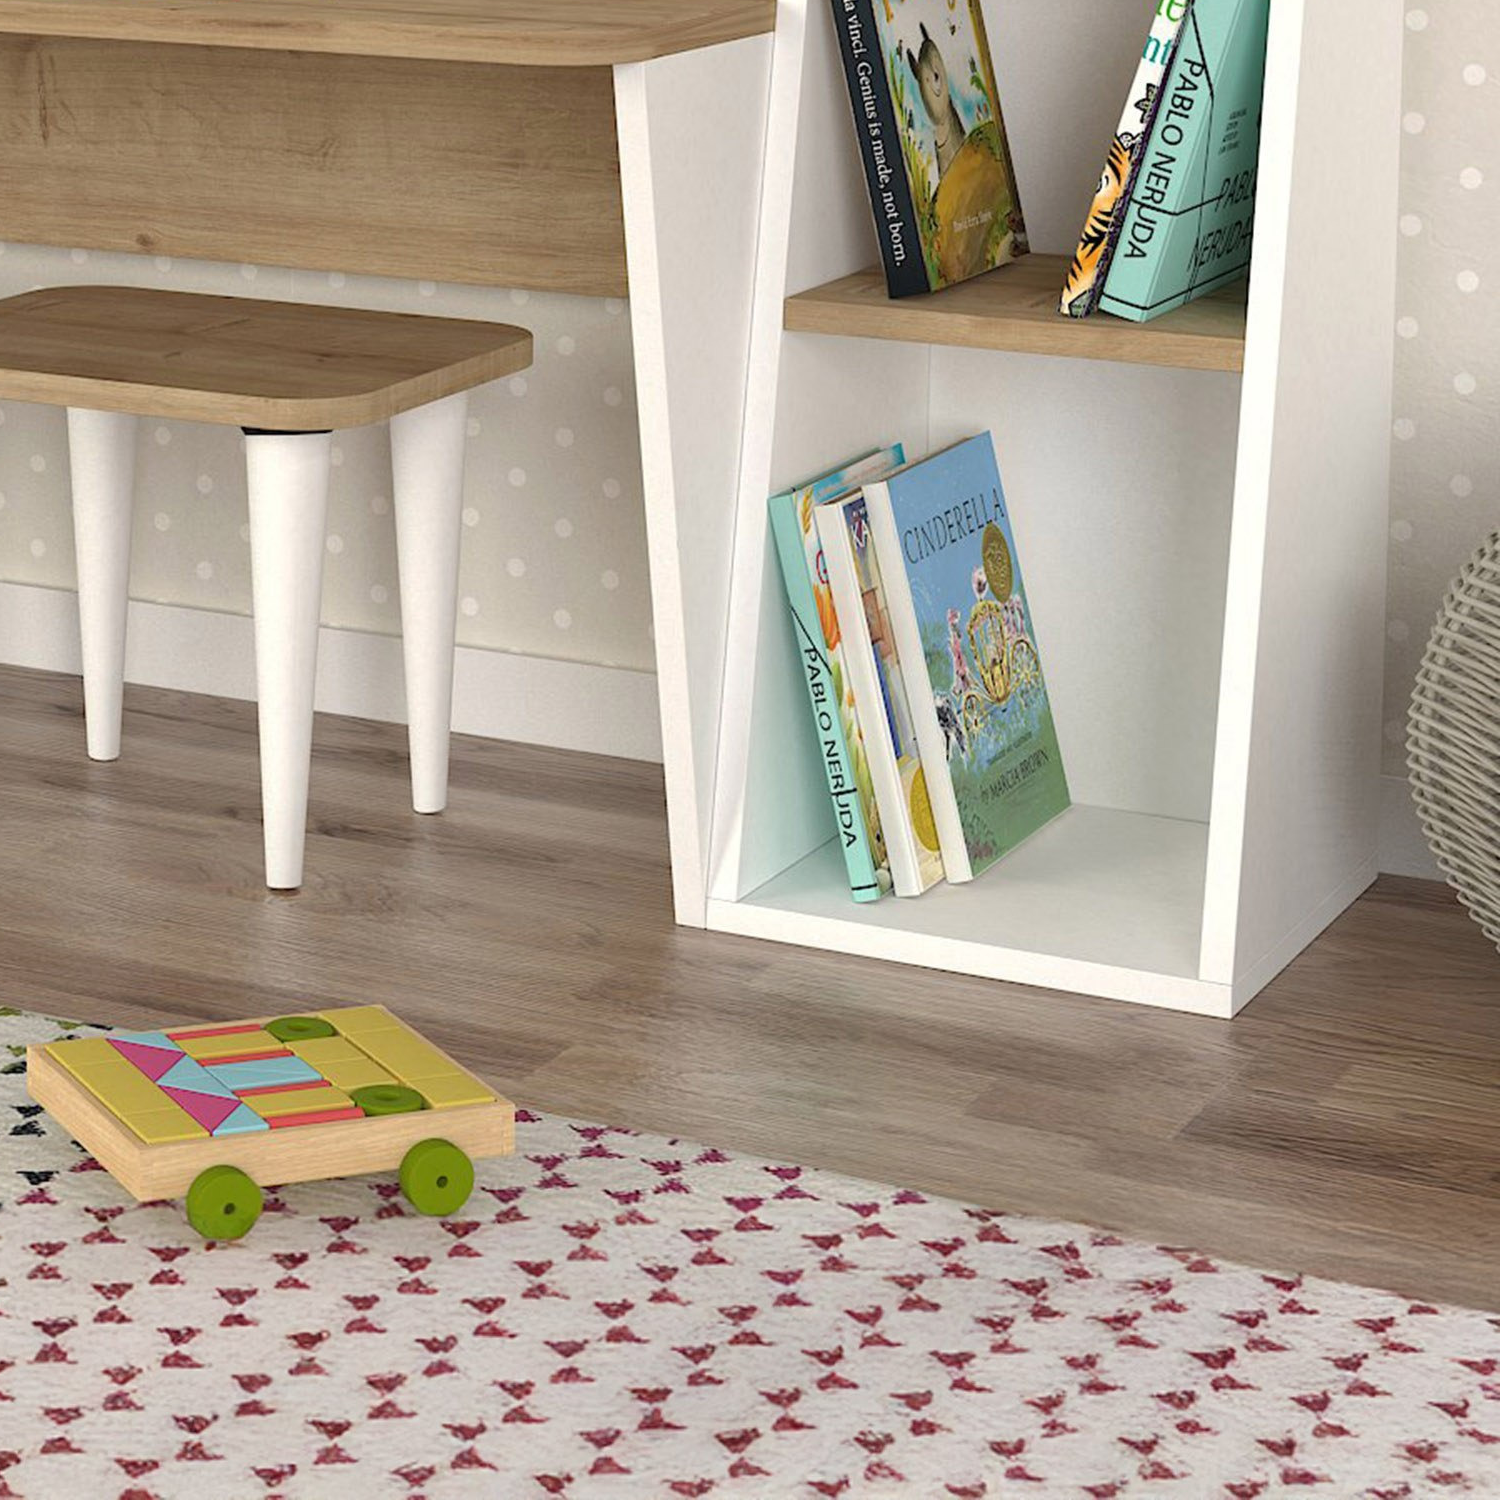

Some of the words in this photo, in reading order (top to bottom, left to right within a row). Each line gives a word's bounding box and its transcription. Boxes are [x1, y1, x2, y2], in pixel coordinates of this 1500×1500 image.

[847, 14, 867, 59] vinci.
[856, 61, 878, 120] Genius
[1160, 58, 1206, 146] PABLO
[868, 122, 882, 137] is
[871, 139, 893, 189] made,
[882, 190, 900, 219] not
[1123, 151, 1177, 258] NERUDA
[888, 222, 907, 267] born.
[903, 484, 1004, 564] CINDERELLA
[804, 648, 833, 731] PABLO
[823, 739, 858, 848] NERUDA
